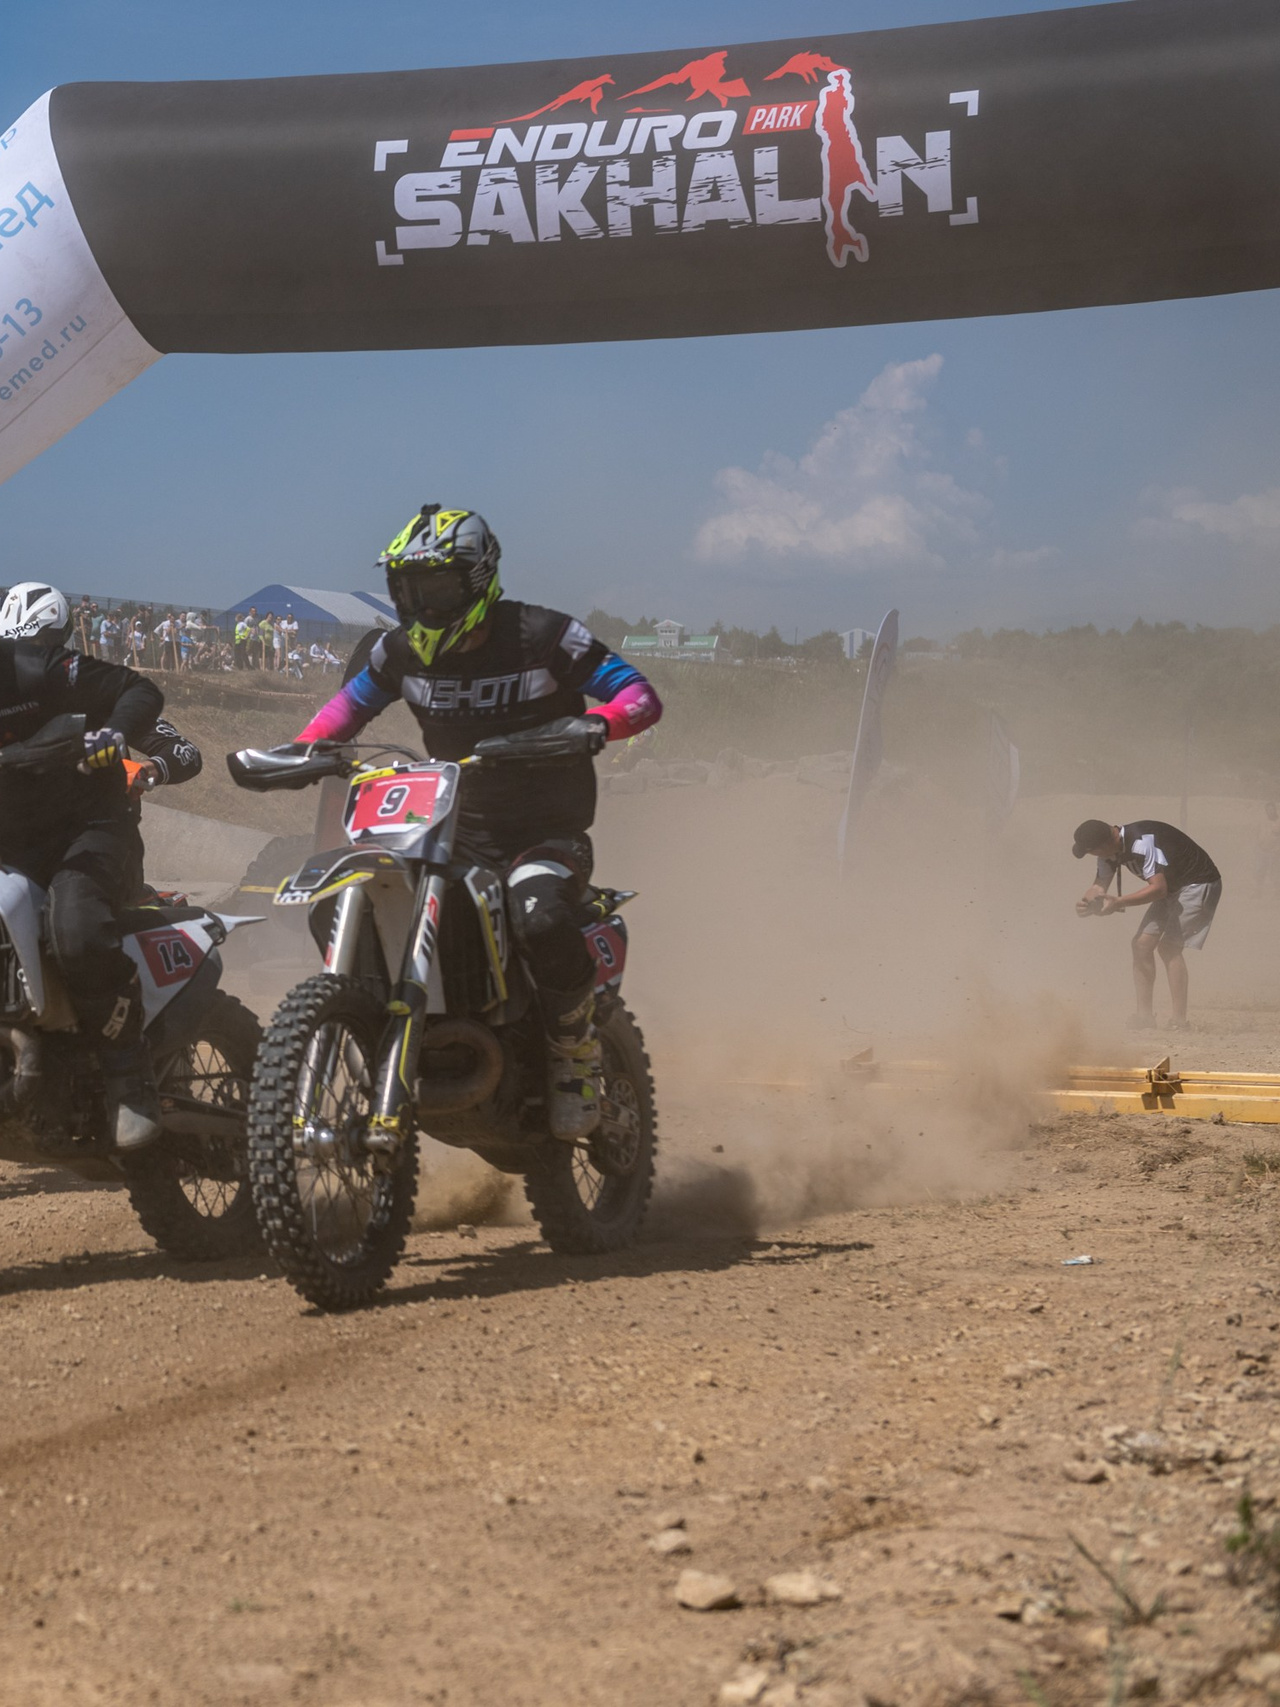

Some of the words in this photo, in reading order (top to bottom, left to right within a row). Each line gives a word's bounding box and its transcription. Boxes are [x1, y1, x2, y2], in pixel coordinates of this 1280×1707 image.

[440, 109, 738, 168] ENDURO
[751, 103, 807, 132] PARK
[393, 129, 953, 251] SAKHALIN
[431, 673, 519, 708] SHOT
[376, 785, 410, 817] 9
[157, 940, 193, 975] 14
[593, 934, 616, 968] 9
